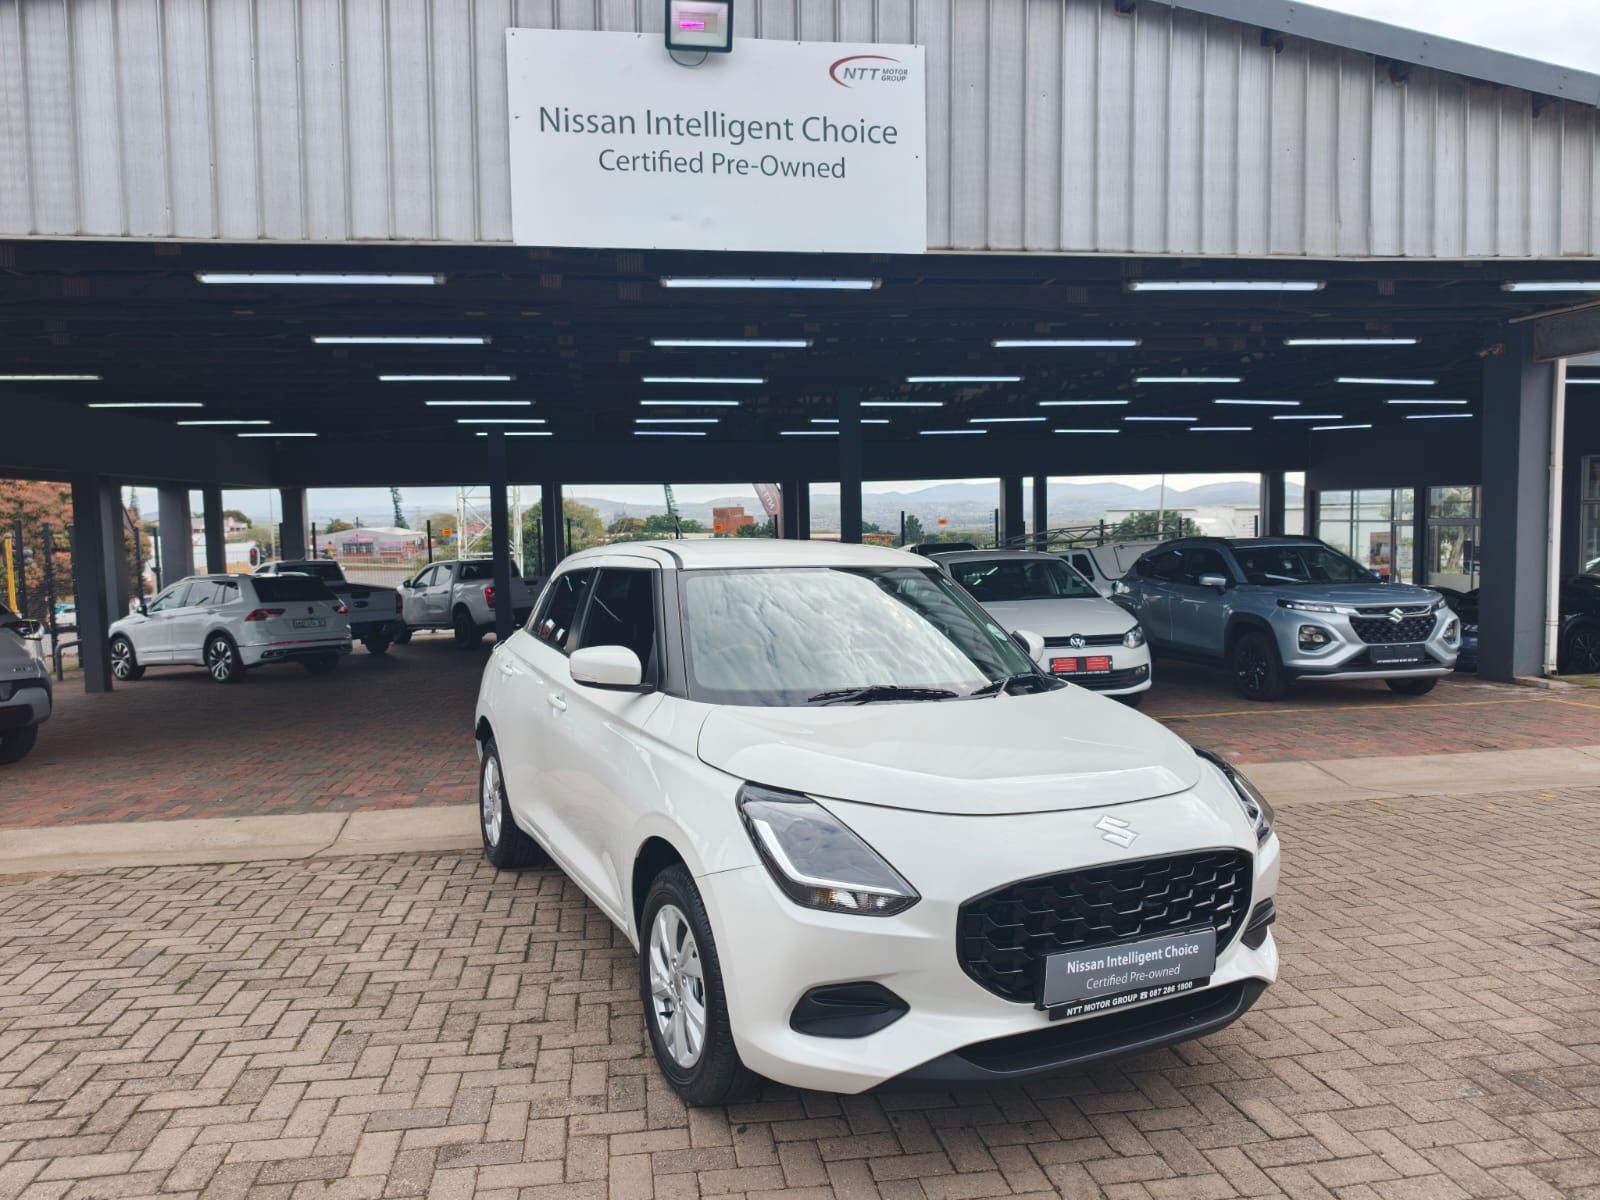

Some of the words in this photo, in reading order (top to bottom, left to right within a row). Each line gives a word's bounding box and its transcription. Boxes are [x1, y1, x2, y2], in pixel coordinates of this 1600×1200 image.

[843, 67, 881, 81] NTT
[539, 106, 636, 134] Nissan
[646, 109, 794, 146] Intelligent
[802, 116, 898, 145] Choice
[599, 149, 704, 174] Certified
[712, 152, 846, 179] Pre-Owned
[1067, 960, 1104, 974] Nissan
[1107, 948, 1163, 968] Intelligent
[1164, 944, 1200, 958] Choice
[1086, 973, 1129, 990] Certified
[1130, 963, 1181, 983] Pre-owned
[1066, 1005, 1083, 1017] NTT
[1084, 999, 1111, 1012] MOTOR
[1112, 993, 1138, 1006] GROUP
